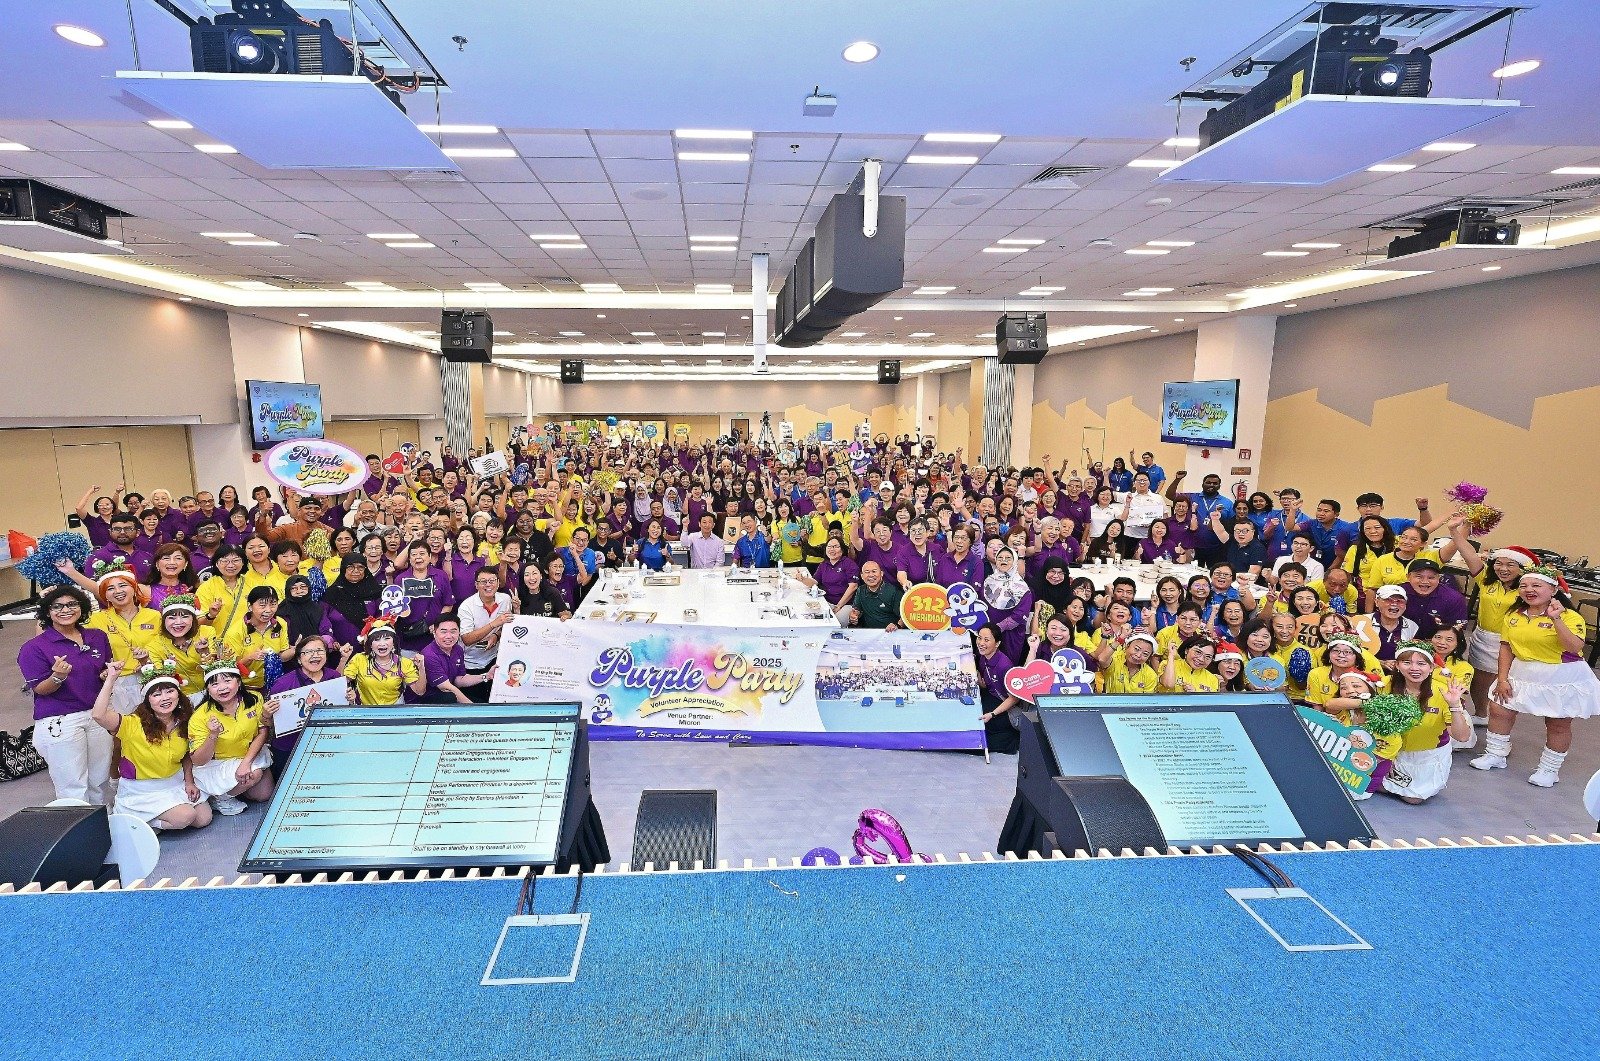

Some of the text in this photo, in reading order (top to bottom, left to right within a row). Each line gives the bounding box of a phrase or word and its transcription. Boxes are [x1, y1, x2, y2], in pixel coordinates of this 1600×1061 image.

[289, 445, 343, 467] Purple
[296, 464, 350, 485] Party
[912, 595, 946, 612] 312
[909, 613, 946, 624] MERIDIAN
[752, 657, 782, 668] 2025
[588, 647, 805, 705] Purple Party
[650, 696, 725, 709] Volunteer Appreciation
[688, 712, 714, 720] Partner:
[635, 729, 646, 738] To
[648, 730, 672, 738] Serve
